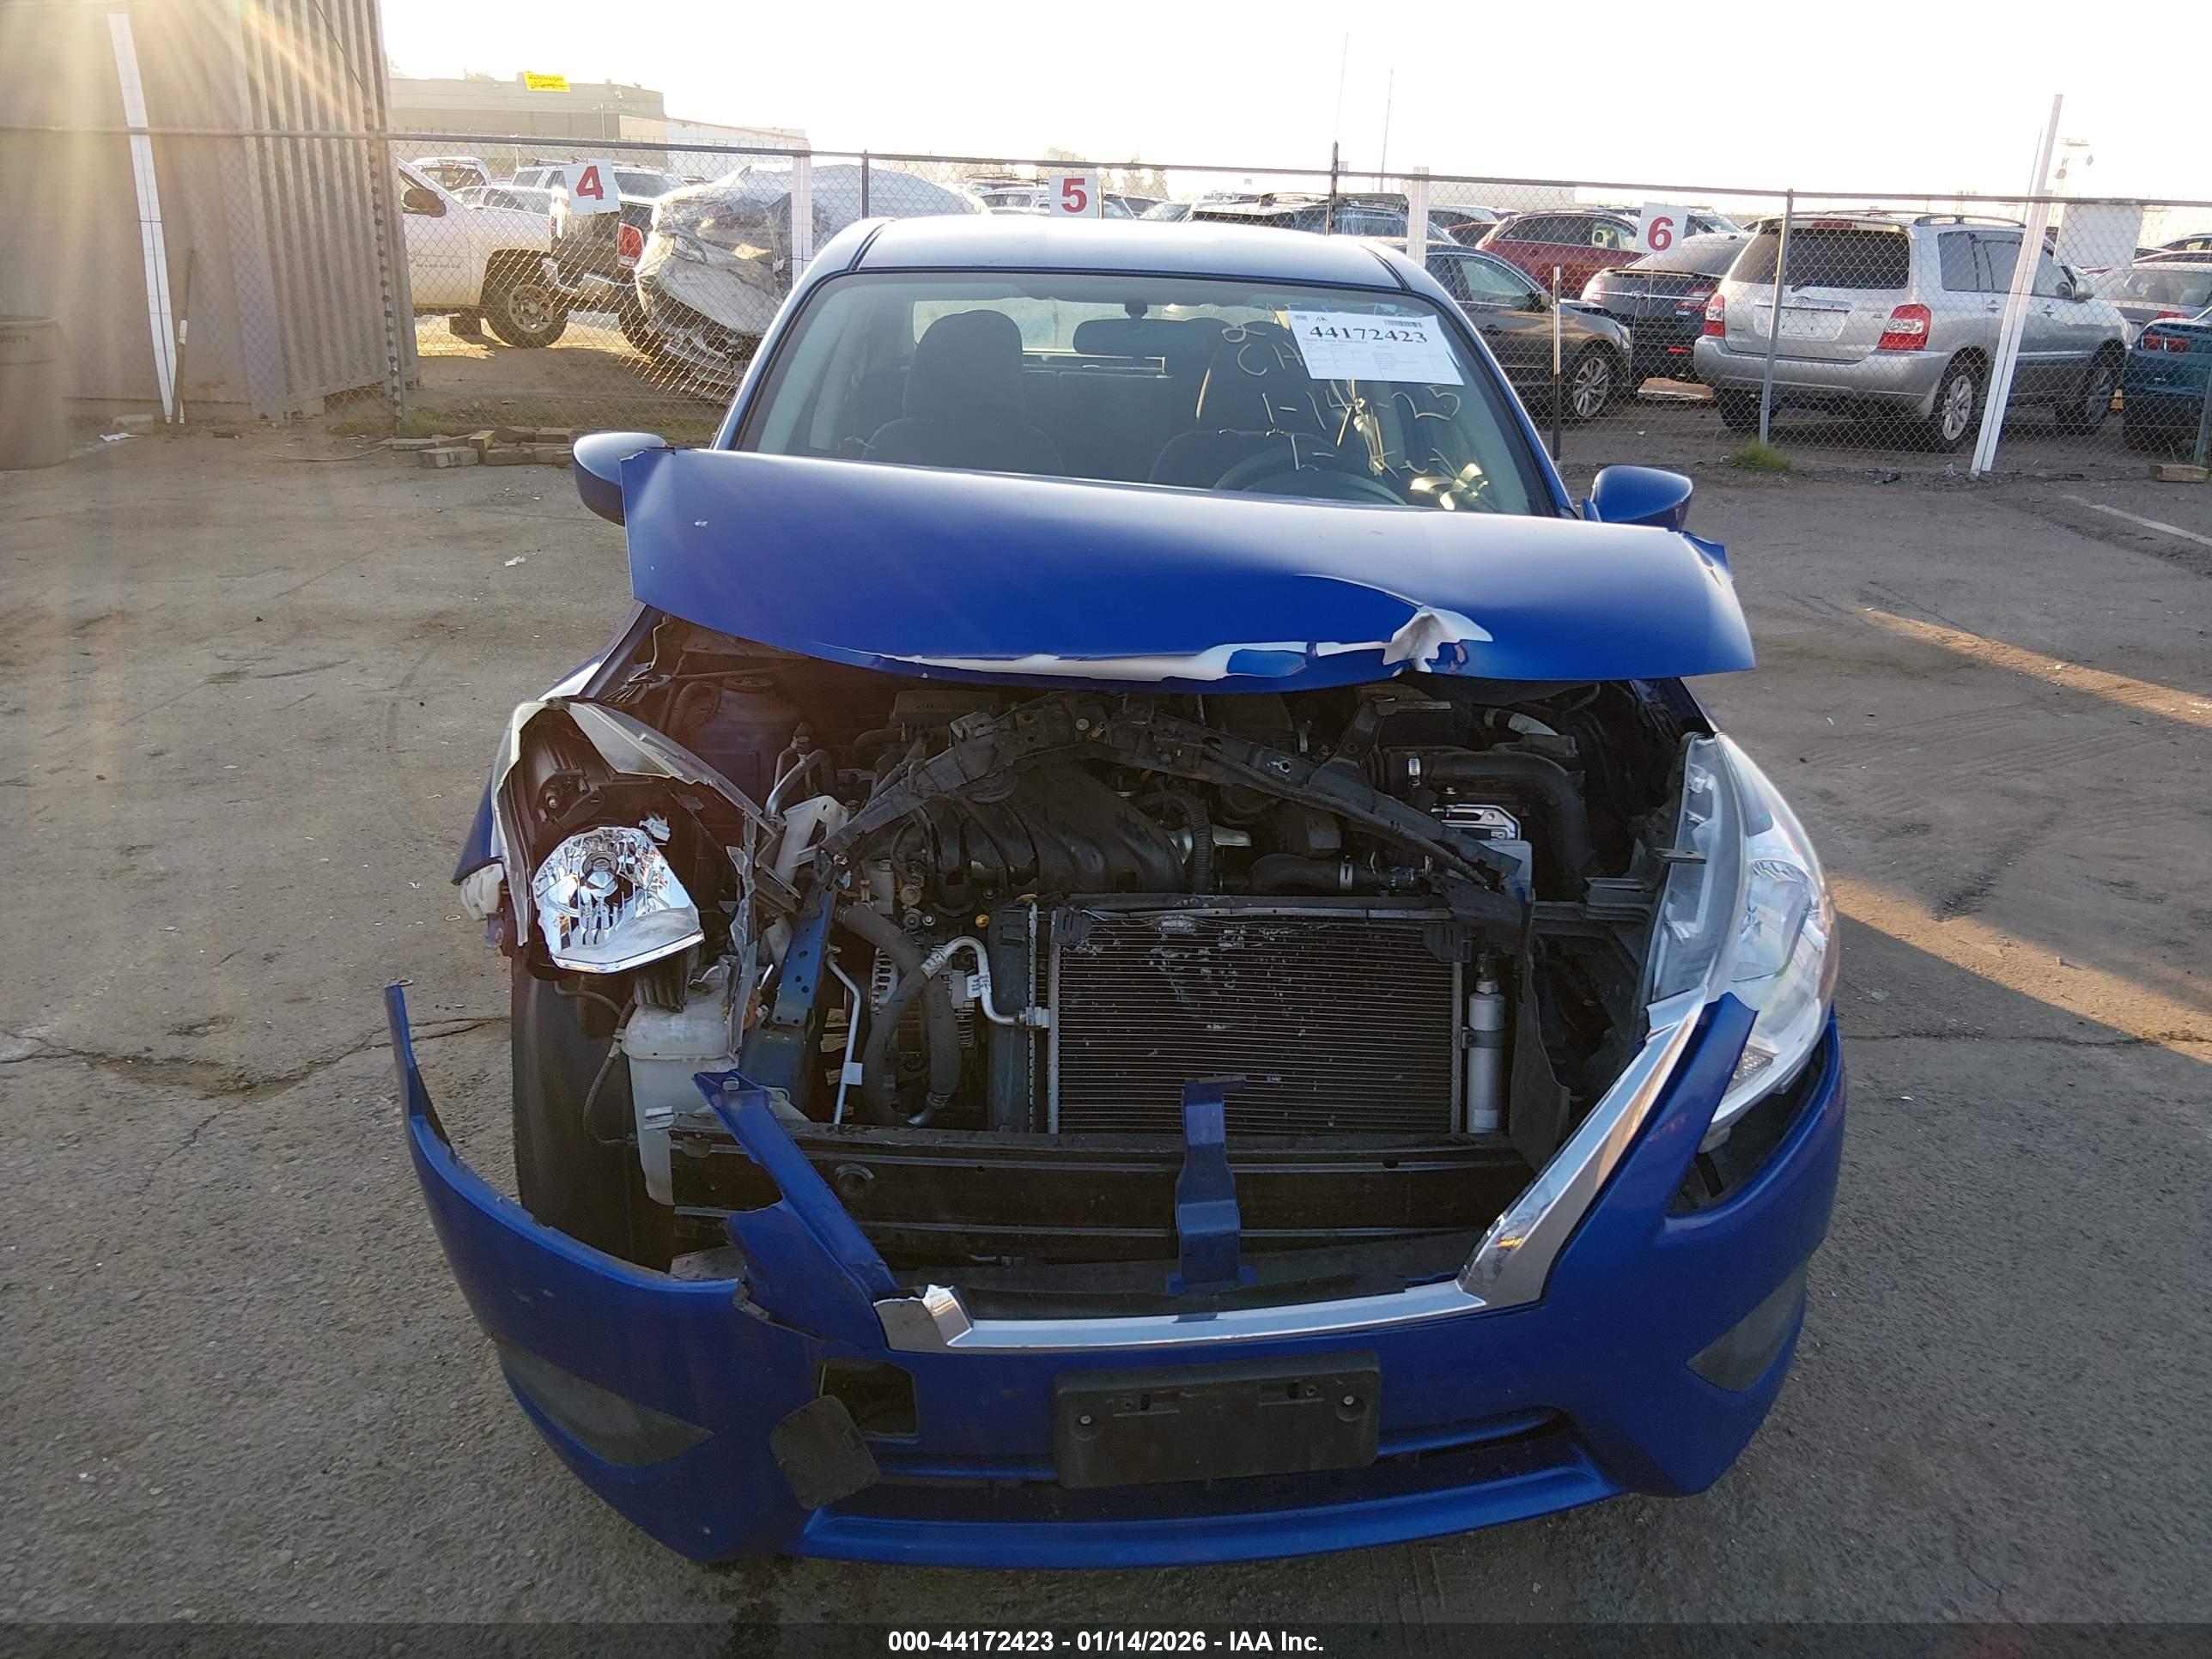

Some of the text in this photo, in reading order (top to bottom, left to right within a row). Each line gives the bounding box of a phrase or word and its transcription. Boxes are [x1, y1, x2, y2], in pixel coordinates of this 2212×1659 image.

[576, 165, 604, 200] 4
[1061, 178, 1087, 213] 5
[1648, 216, 1674, 251] 6
[1310, 325, 1428, 344] 44172423
